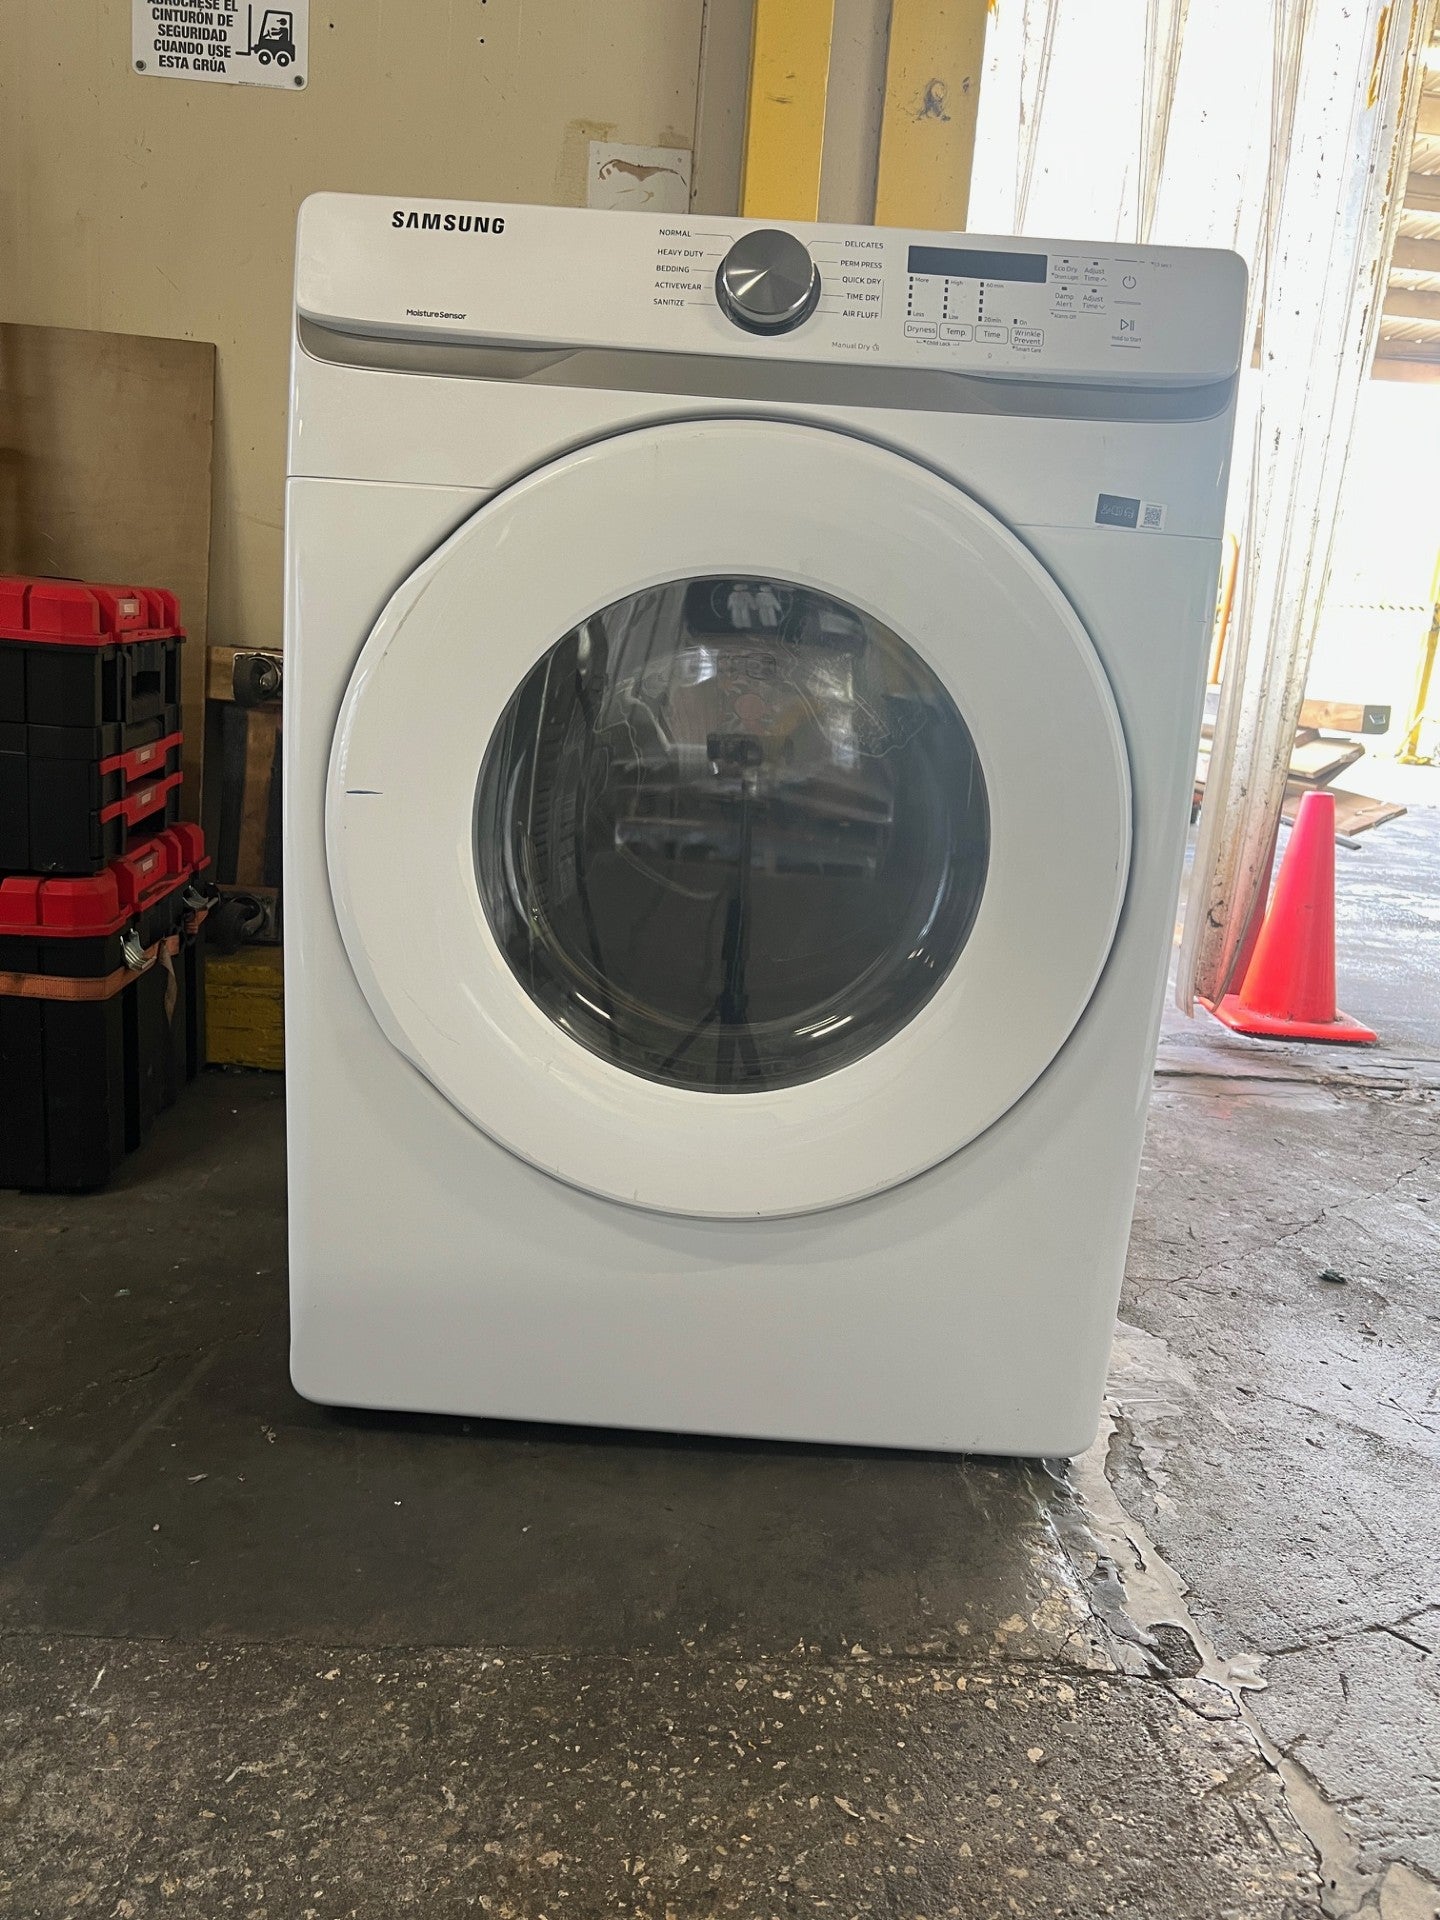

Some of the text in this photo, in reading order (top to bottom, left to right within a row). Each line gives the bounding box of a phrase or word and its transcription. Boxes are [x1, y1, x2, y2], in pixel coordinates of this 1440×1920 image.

[224, 0, 238, 12] EL
[152, 7, 234, 27] CINTURÓN DE
[158, 24, 227, 42] SEGURIDAD
[153, 39, 231, 58] CUANDO USE
[158, 56, 226, 73] ESTA GRÚA
[392, 211, 505, 234] SAMSUNG
[659, 229, 692, 237] NORMAL
[844, 240, 884, 250] DELICATES
[657, 248, 704, 258] HEAVY DUTY
[656, 265, 690, 273] BEDDING
[840, 260, 883, 269] PERM PRESS
[1066, 266, 1078, 274] Dry
[1084, 267, 1105, 275] Adjust
[842, 276, 882, 285] QUICK DRY
[654, 282, 702, 290] ACTIVEWEAR
[846, 293, 880, 302] TIME DRY
[1055, 293, 1074, 301] Damp
[1083, 295, 1103, 303] Adjust
[653, 298, 685, 307] SANITIZE
[842, 310, 879, 320] AIR FLUFF
[907, 325, 936, 334] Dryness
[1014, 329, 1041, 338] Wrinkle
[984, 330, 1001, 339] Time
[1014, 337, 1041, 345] Prevent
[832, 341, 871, 352] Manual Dry
